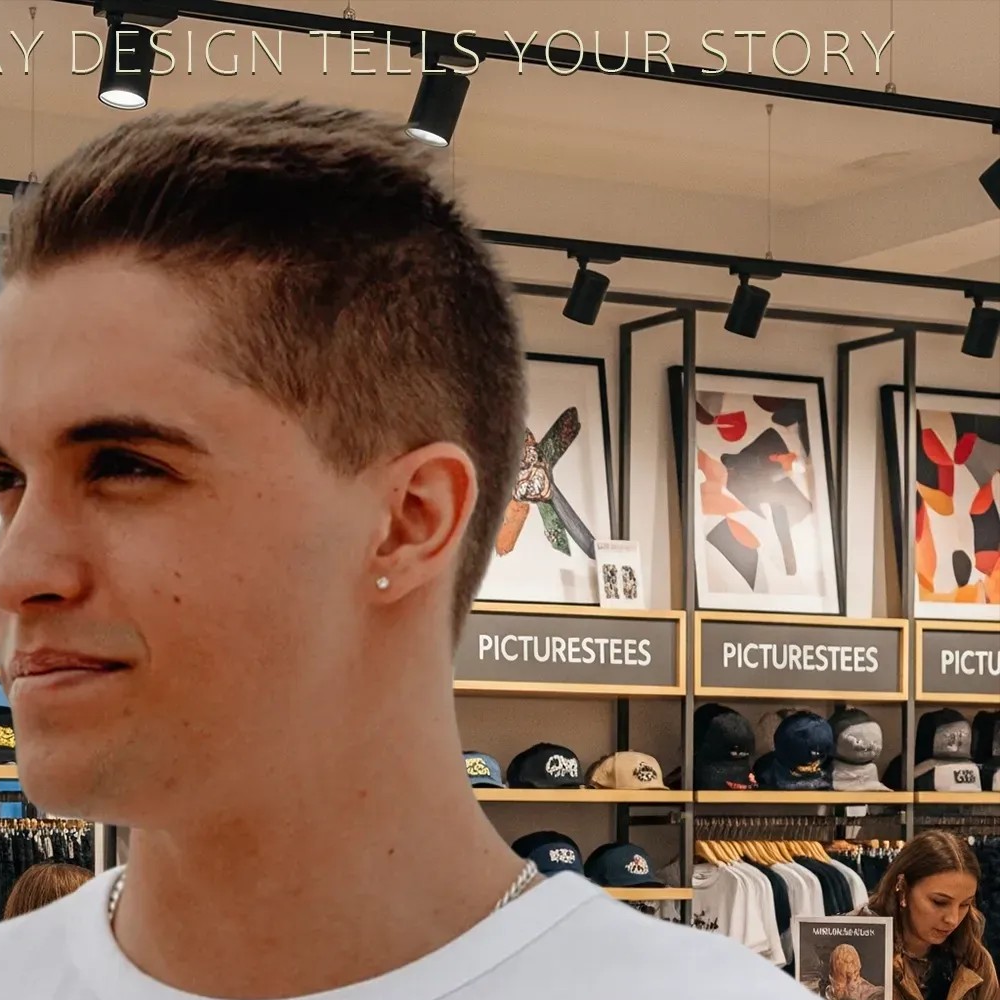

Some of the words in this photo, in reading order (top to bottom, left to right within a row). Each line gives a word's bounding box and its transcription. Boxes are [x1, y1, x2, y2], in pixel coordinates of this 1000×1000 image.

[478, 634, 652, 667] PICTURESTEES
[723, 641, 879, 673] PICTURESTEES
[940, 649, 1000, 676] PICTU
